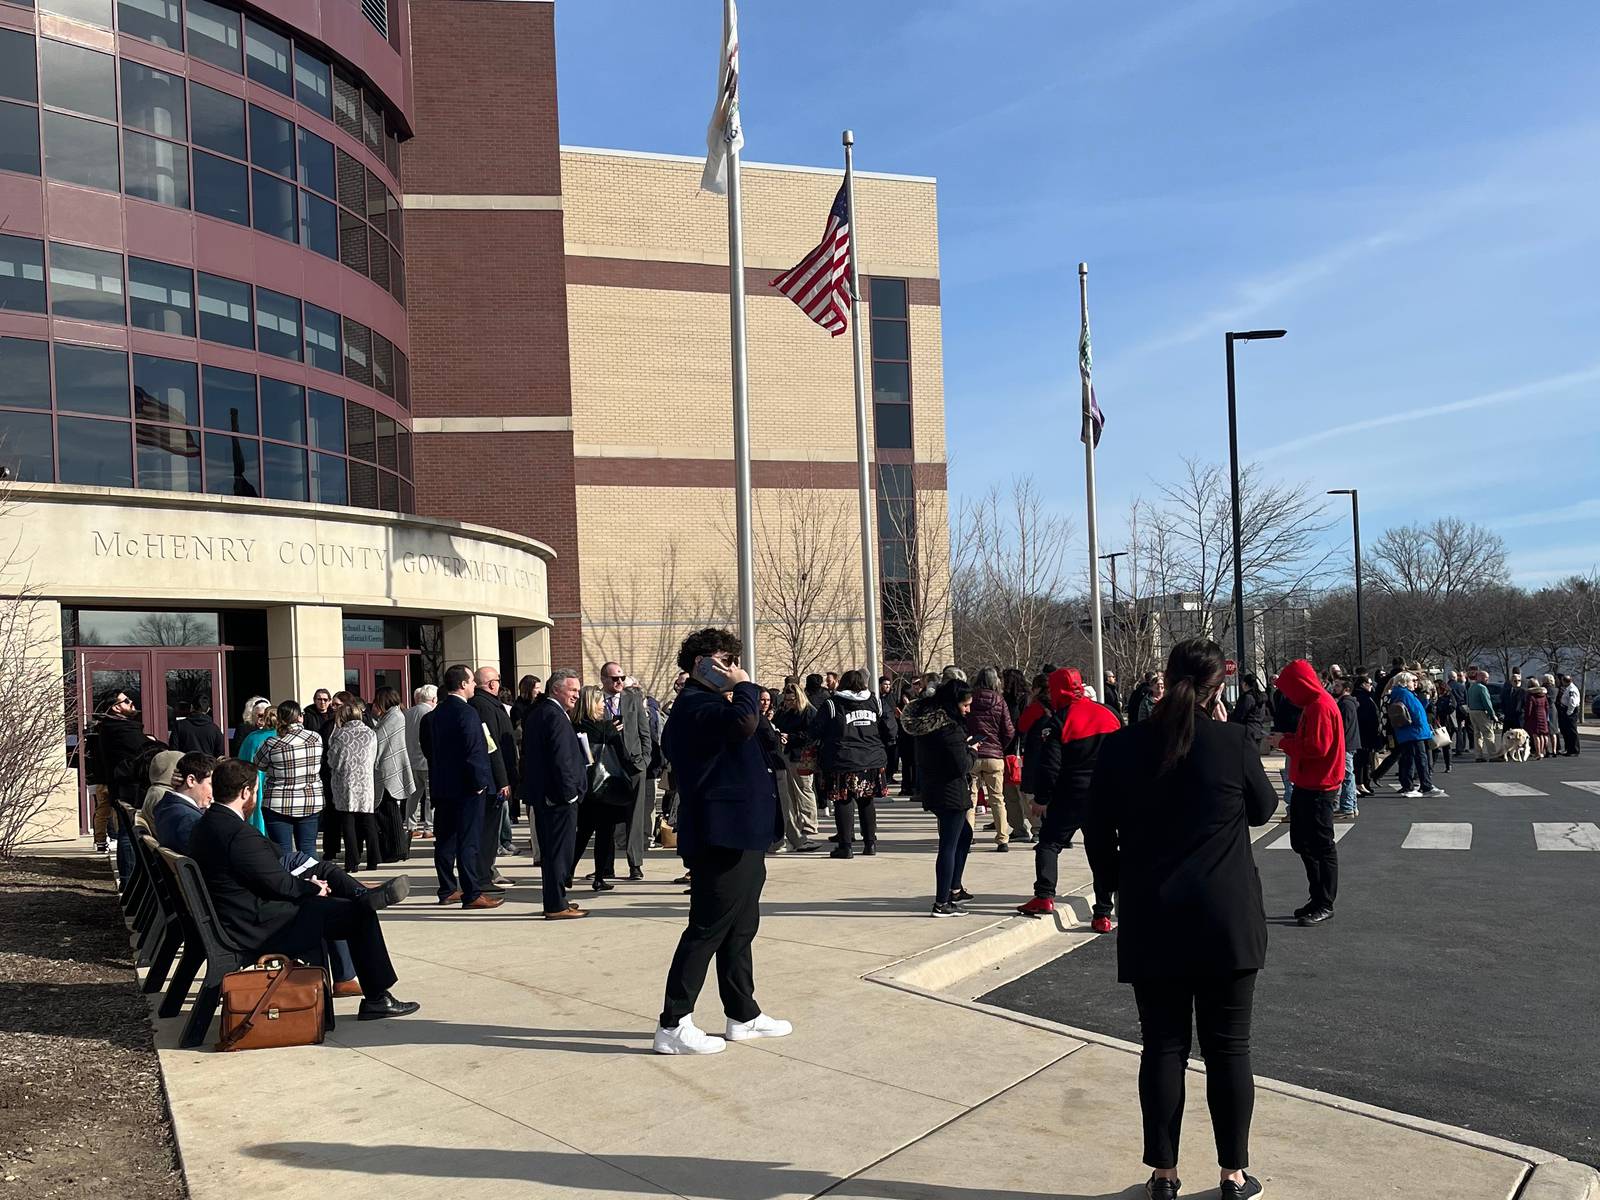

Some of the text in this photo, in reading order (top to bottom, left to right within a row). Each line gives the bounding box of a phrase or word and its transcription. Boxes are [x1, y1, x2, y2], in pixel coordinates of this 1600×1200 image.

[91, 530, 256, 562] McHENRY
[279, 541, 388, 571] COUNTY
[402, 551, 509, 586] GOVERNMENT
